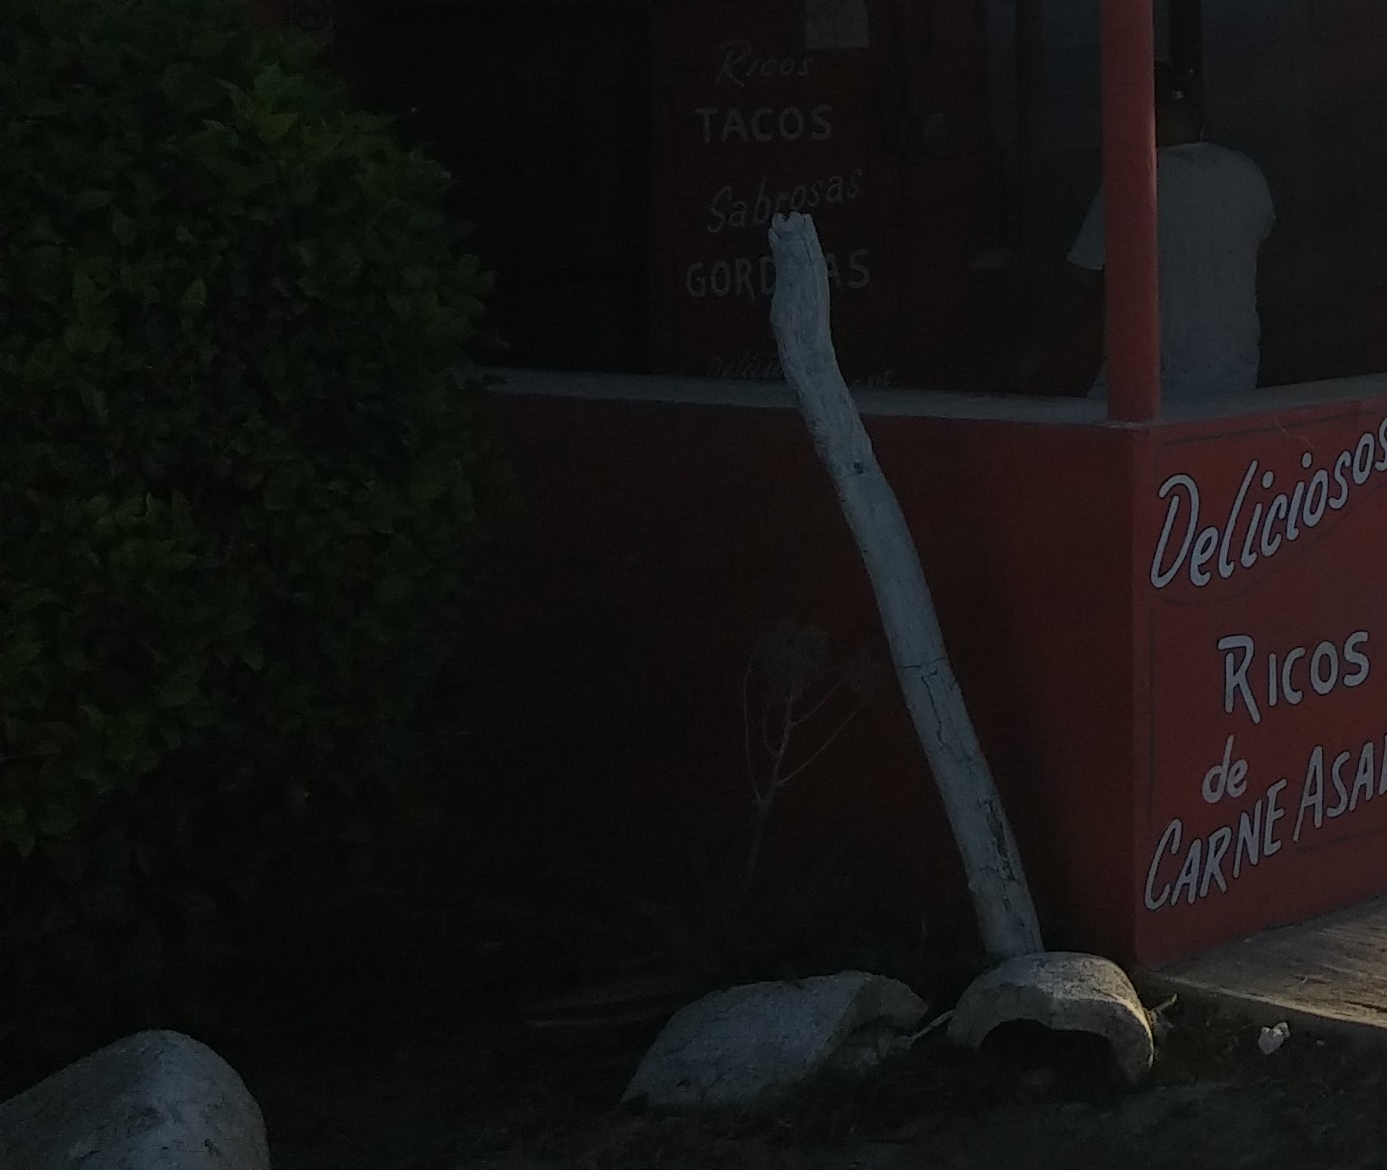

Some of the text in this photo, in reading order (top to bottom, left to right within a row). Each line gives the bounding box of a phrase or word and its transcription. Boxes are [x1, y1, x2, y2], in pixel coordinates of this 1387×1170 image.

[694, 103, 833, 144] TACOS
[706, 167, 863, 233] Sabrosas
[685, 246, 870, 304] GORDAS
[1217, 631, 1371, 724] RICOS
[1201, 735, 1248, 804] de
[1144, 779, 1288, 912] CARNE
